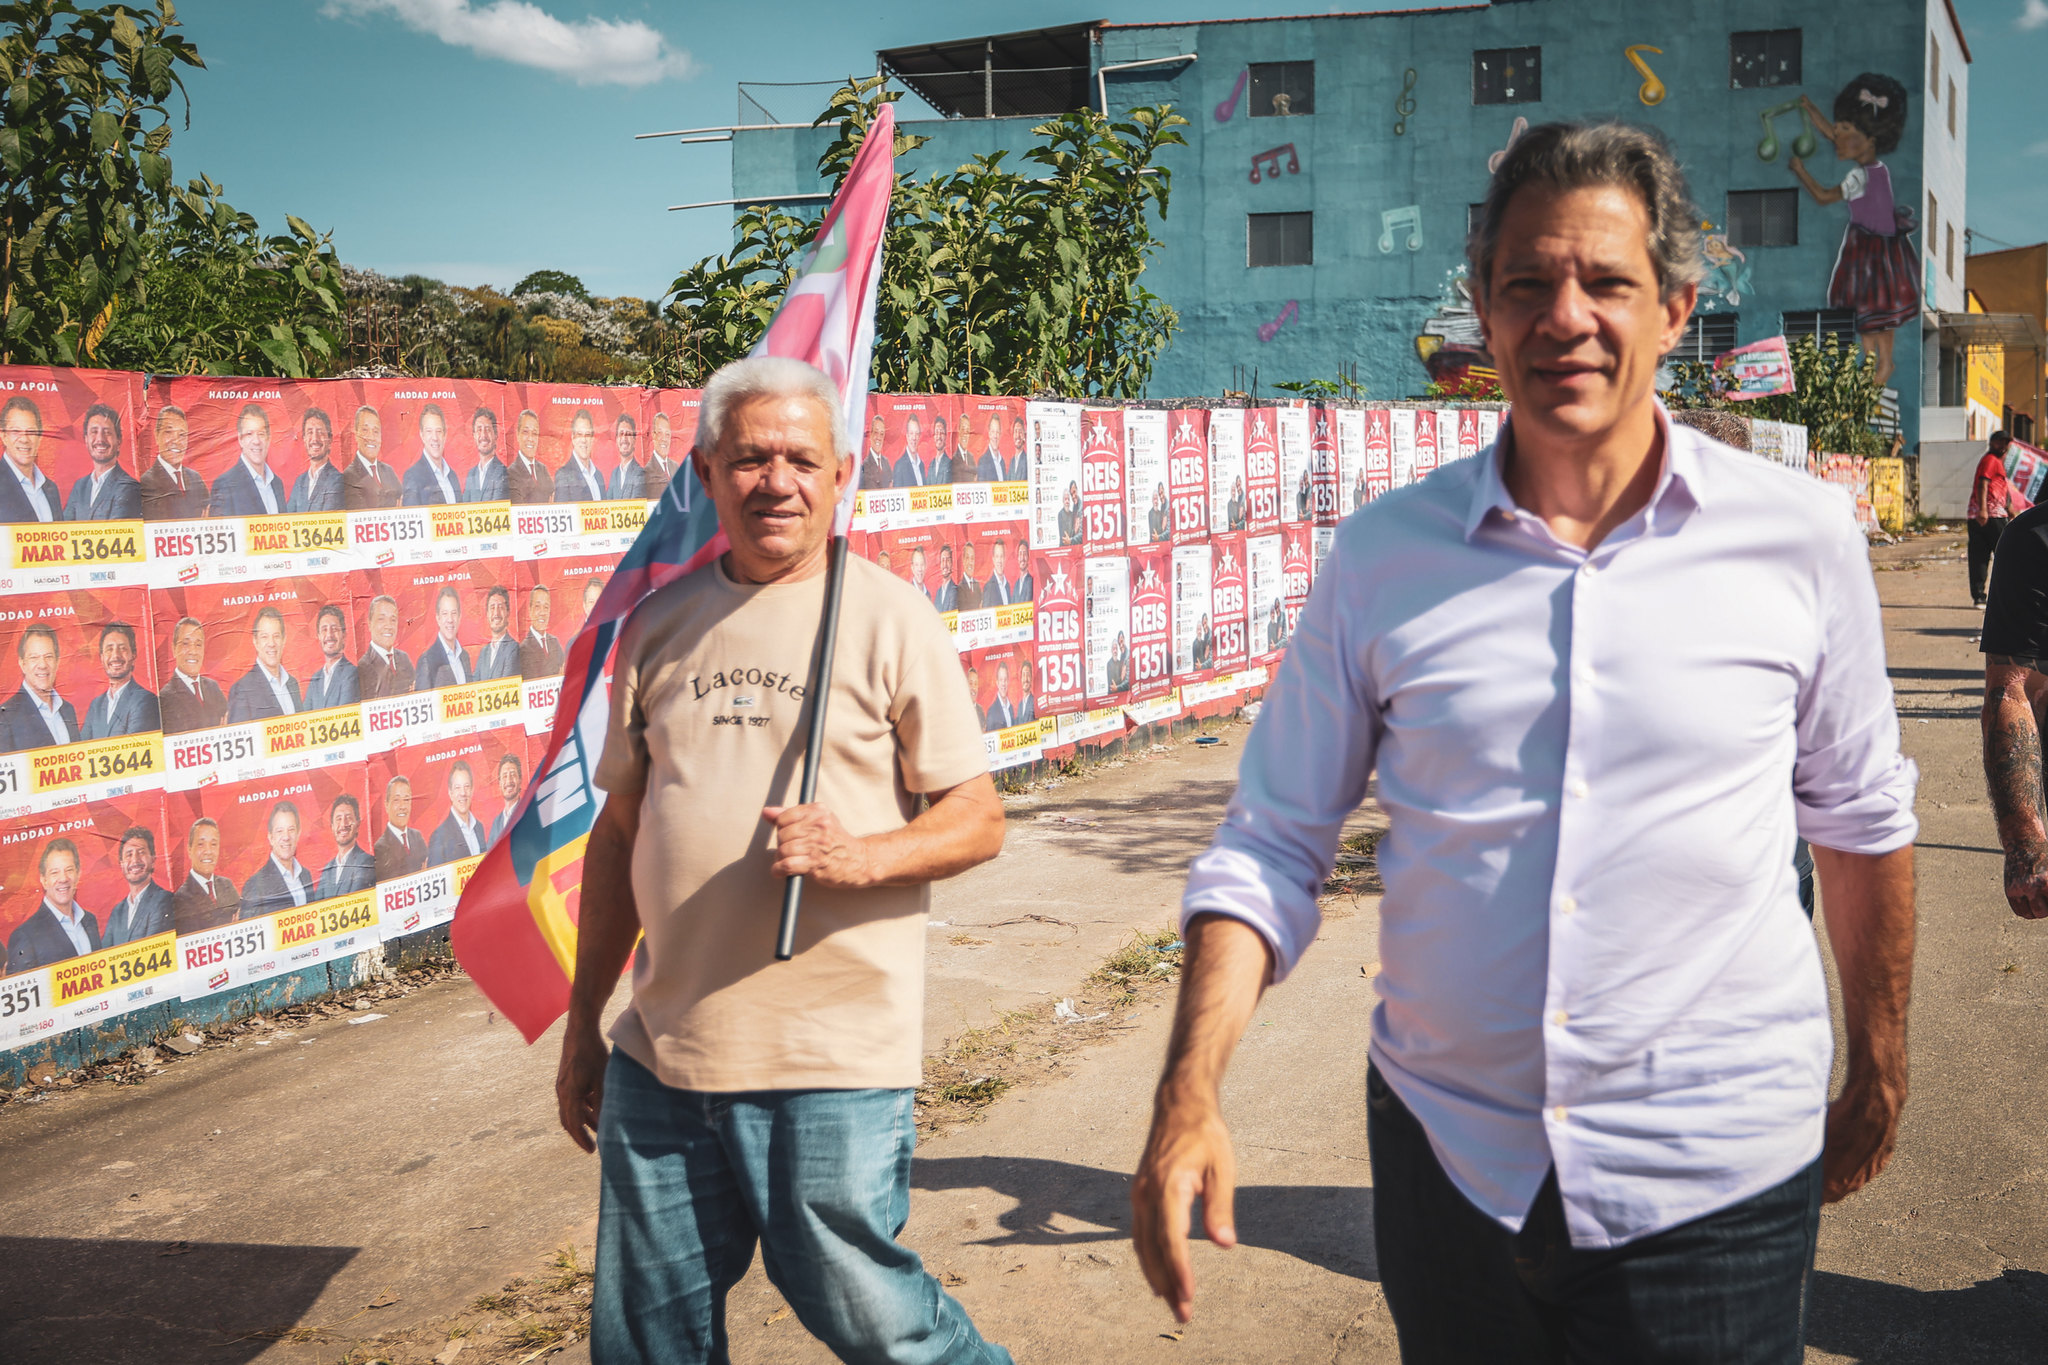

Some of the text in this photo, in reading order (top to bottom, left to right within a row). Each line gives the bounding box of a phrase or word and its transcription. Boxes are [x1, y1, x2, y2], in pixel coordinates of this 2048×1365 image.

[20, 381, 58, 393] APOIA
[208, 390, 282, 400] HADDAD APOIA
[394, 391, 429, 399] HADDAD
[552, 397, 580, 405] HADDAD
[1248, 451, 1276, 478] REIS
[1312, 450, 1336, 473] REIS
[1367, 448, 1389, 471] REIS
[1417, 446, 1436, 467] REIS
[1083, 461, 1120, 491] REIS
[1170, 456, 1204, 486] REIS
[912, 494, 952, 510] MAR 13644
[994, 491, 1029, 504] MAR 13644
[1249, 487, 1278, 519] 1351
[1312, 484, 1337, 512] 1351
[432, 511, 466, 521] RODRIGO
[581, 508, 609, 516] RODRIGO
[584, 512, 645, 530] MAR 13644
[1083, 503, 1122, 541] 1351
[1172, 496, 1205, 531] 1351
[154, 526, 195, 535] DEPUTADO
[249, 522, 290, 534] RODRIGO
[354, 520, 424, 543] REIS 1351
[436, 514, 511, 537] MAR 13644
[518, 515, 573, 534] REIS 1351
[16, 531, 68, 543] RODRIGO
[154, 532, 236, 558] REIS 1351
[254, 527, 344, 551] MAR 13644
[21, 537, 136, 563] MAR 13644
[284, 561, 292, 569] 13
[564, 567, 592, 576] HADDAD
[60, 574, 70, 584] 13
[414, 572, 471, 585] HADDAD APOIA
[1283, 571, 1308, 597] REIS
[223, 591, 298, 606] HADDAD APOIA
[1213, 585, 1244, 614] REIS
[38, 606, 75, 618] APOIA
[998, 612, 1034, 628] MAR 13644
[1132, 602, 1167, 634] REIS
[1038, 610, 1080, 642] REIS
[1214, 621, 1245, 657] 1351
[1132, 642, 1168, 681] 1351
[1037, 653, 1081, 694] 1351
[690, 668, 807, 701] Lacoste
[443, 690, 476, 703] RODRIGO
[446, 690, 520, 718] MAR 13644
[528, 689, 555, 709] REIS
[370, 703, 434, 732] REIS 1351
[712, 715, 770, 727] SINCE 1927
[174, 730, 252, 746] DEPUTADO FEDERAL
[266, 721, 308, 736] RODRIGO
[271, 719, 360, 752] MAR 13644
[1001, 738, 1015, 750] MAR
[1016, 732, 1037, 747] 13644
[34, 740, 152, 767] RODRIGO DEPUTADO ESTADUAL
[174, 736, 254, 769] REIS 1351
[426, 745, 482, 763] HADDAD APOIA
[39, 749, 153, 787] MAR 13644
[77, 794, 88, 803] 13
[239, 784, 313, 804] HADDAD APOIA
[16, 805, 32, 815] 180
[2, 818, 94, 844] HADDAD APOIA
[457, 864, 478, 876] RODR
[384, 887, 415, 913] REIS
[415, 878, 447, 903] 1351
[278, 910, 317, 928] RODRIGO
[282, 905, 371, 944] MAR 13644
[185, 924, 263, 948] DEPUTADO FEDERAL
[185, 930, 265, 969] REIS 1351
[312, 948, 319, 957] 13
[56, 940, 170, 981] RODRIGO DEPUTADO ESTADUAL
[62, 949, 172, 1000] MAR 13644
[100, 1001, 109, 1011] 13
[38, 1018, 54, 1031] 180
